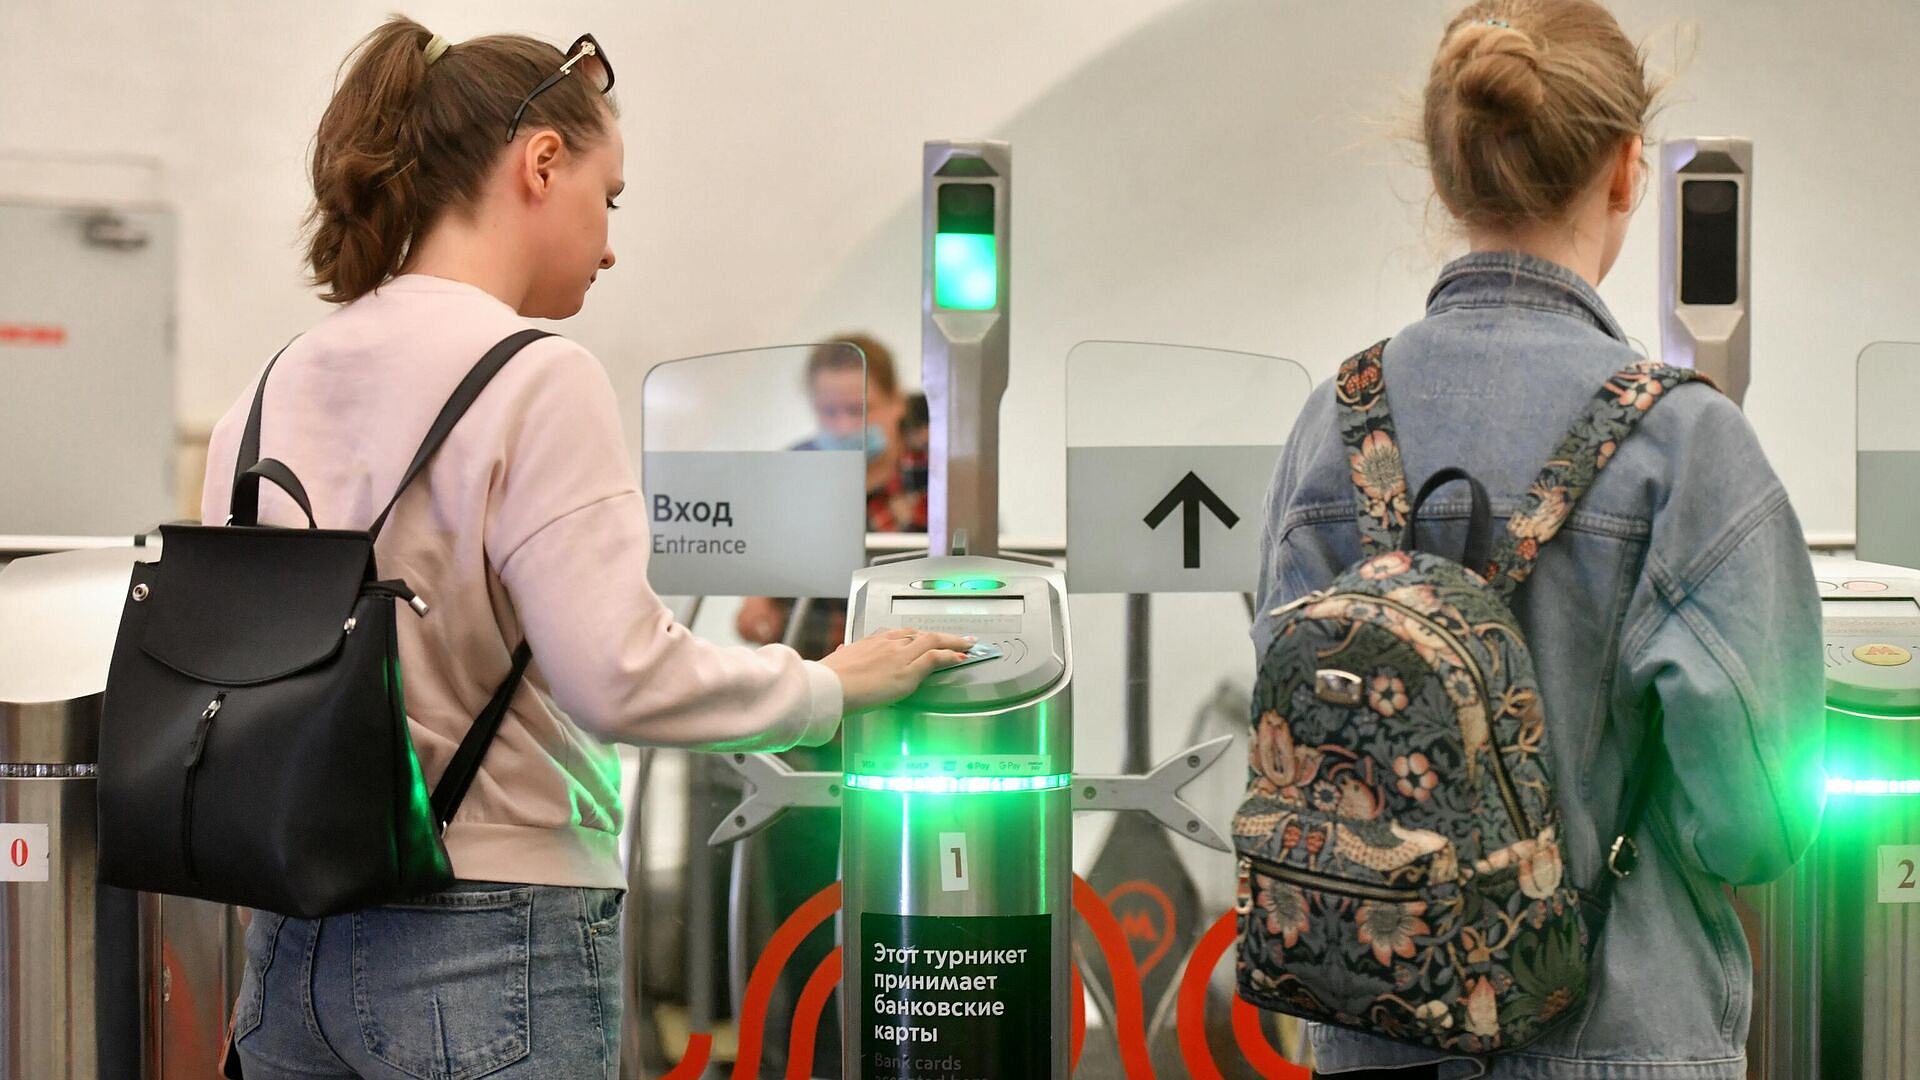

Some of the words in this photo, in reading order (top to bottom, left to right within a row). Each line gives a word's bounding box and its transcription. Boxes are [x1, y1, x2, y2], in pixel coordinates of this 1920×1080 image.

[653, 494, 733, 527] Вход
[653, 534, 746, 554] Entrance
[11, 838, 28, 867] 0
[951, 848, 962, 878] 1
[1897, 859, 1916, 889] 2
[874, 942, 919, 964] Этот
[923, 948, 1027, 969] турникет
[874, 973, 997, 992] принимает
[874, 994, 1005, 1017] банковские
[874, 1024, 938, 1045] карты
[874, 1052, 911, 1069] Bank
[915, 1056, 962, 1070] cards
